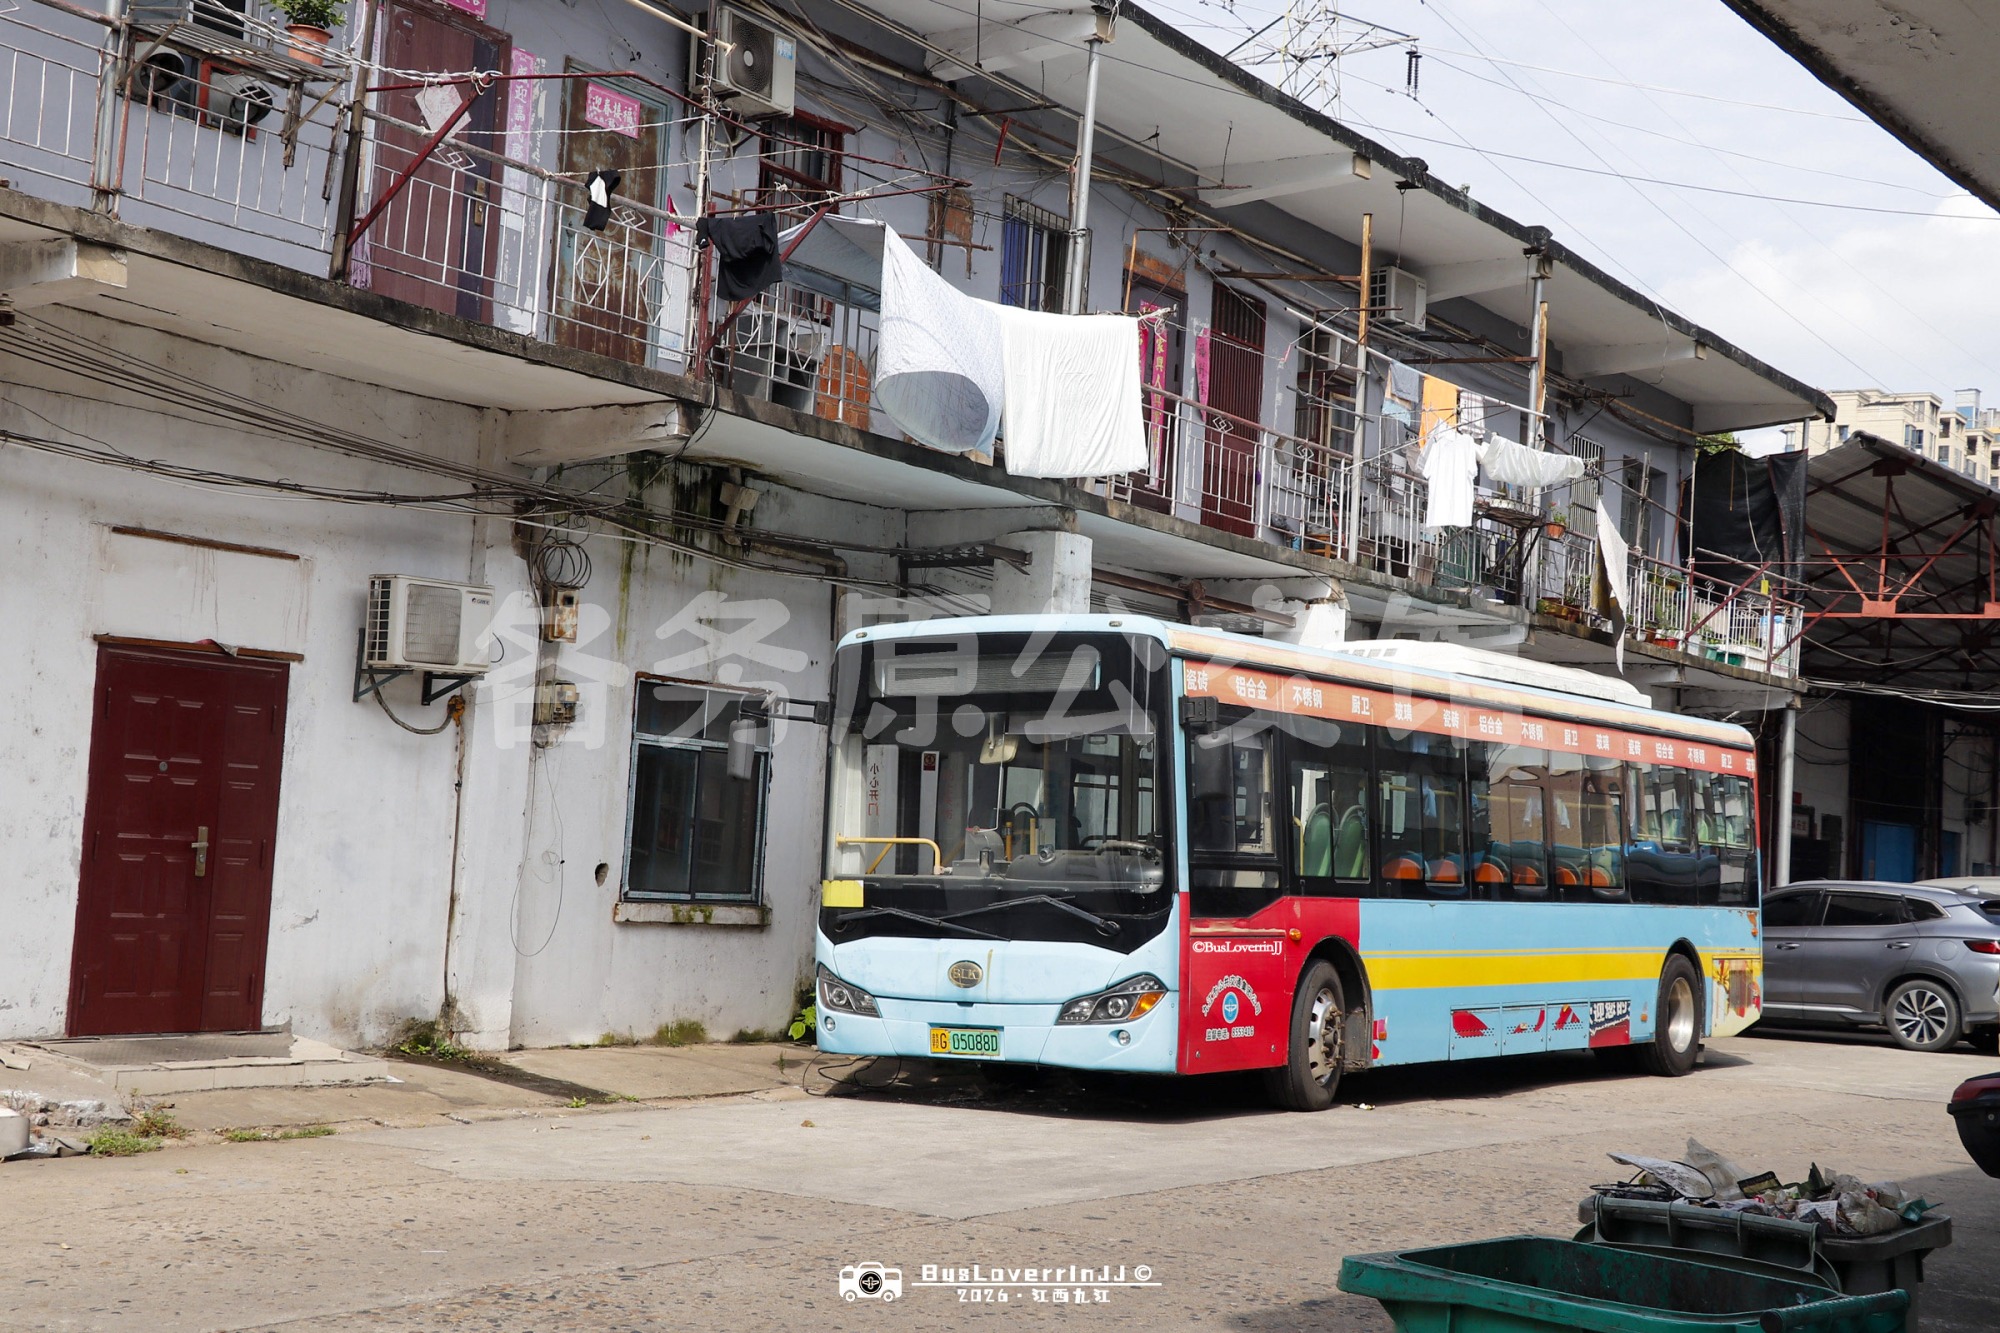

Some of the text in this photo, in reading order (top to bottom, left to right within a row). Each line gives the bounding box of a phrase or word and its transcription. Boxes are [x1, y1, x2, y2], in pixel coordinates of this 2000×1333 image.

[592, 95, 633, 124] 迎春接福
[1186, 669, 1208, 692] 瓷砖
[1235, 676, 1267, 700] 铝合金
[1292, 686, 1323, 709] 不锈钢
[1351, 695, 1370, 716] 厨卫
[1394, 702, 1412, 722] 玻璃
[1443, 709, 1460, 729] 瓷砖
[1479, 716, 1503, 736] 铝合金
[1521, 723, 1543, 742] 不锈钢
[1564, 729, 1578, 747] 厨卫
